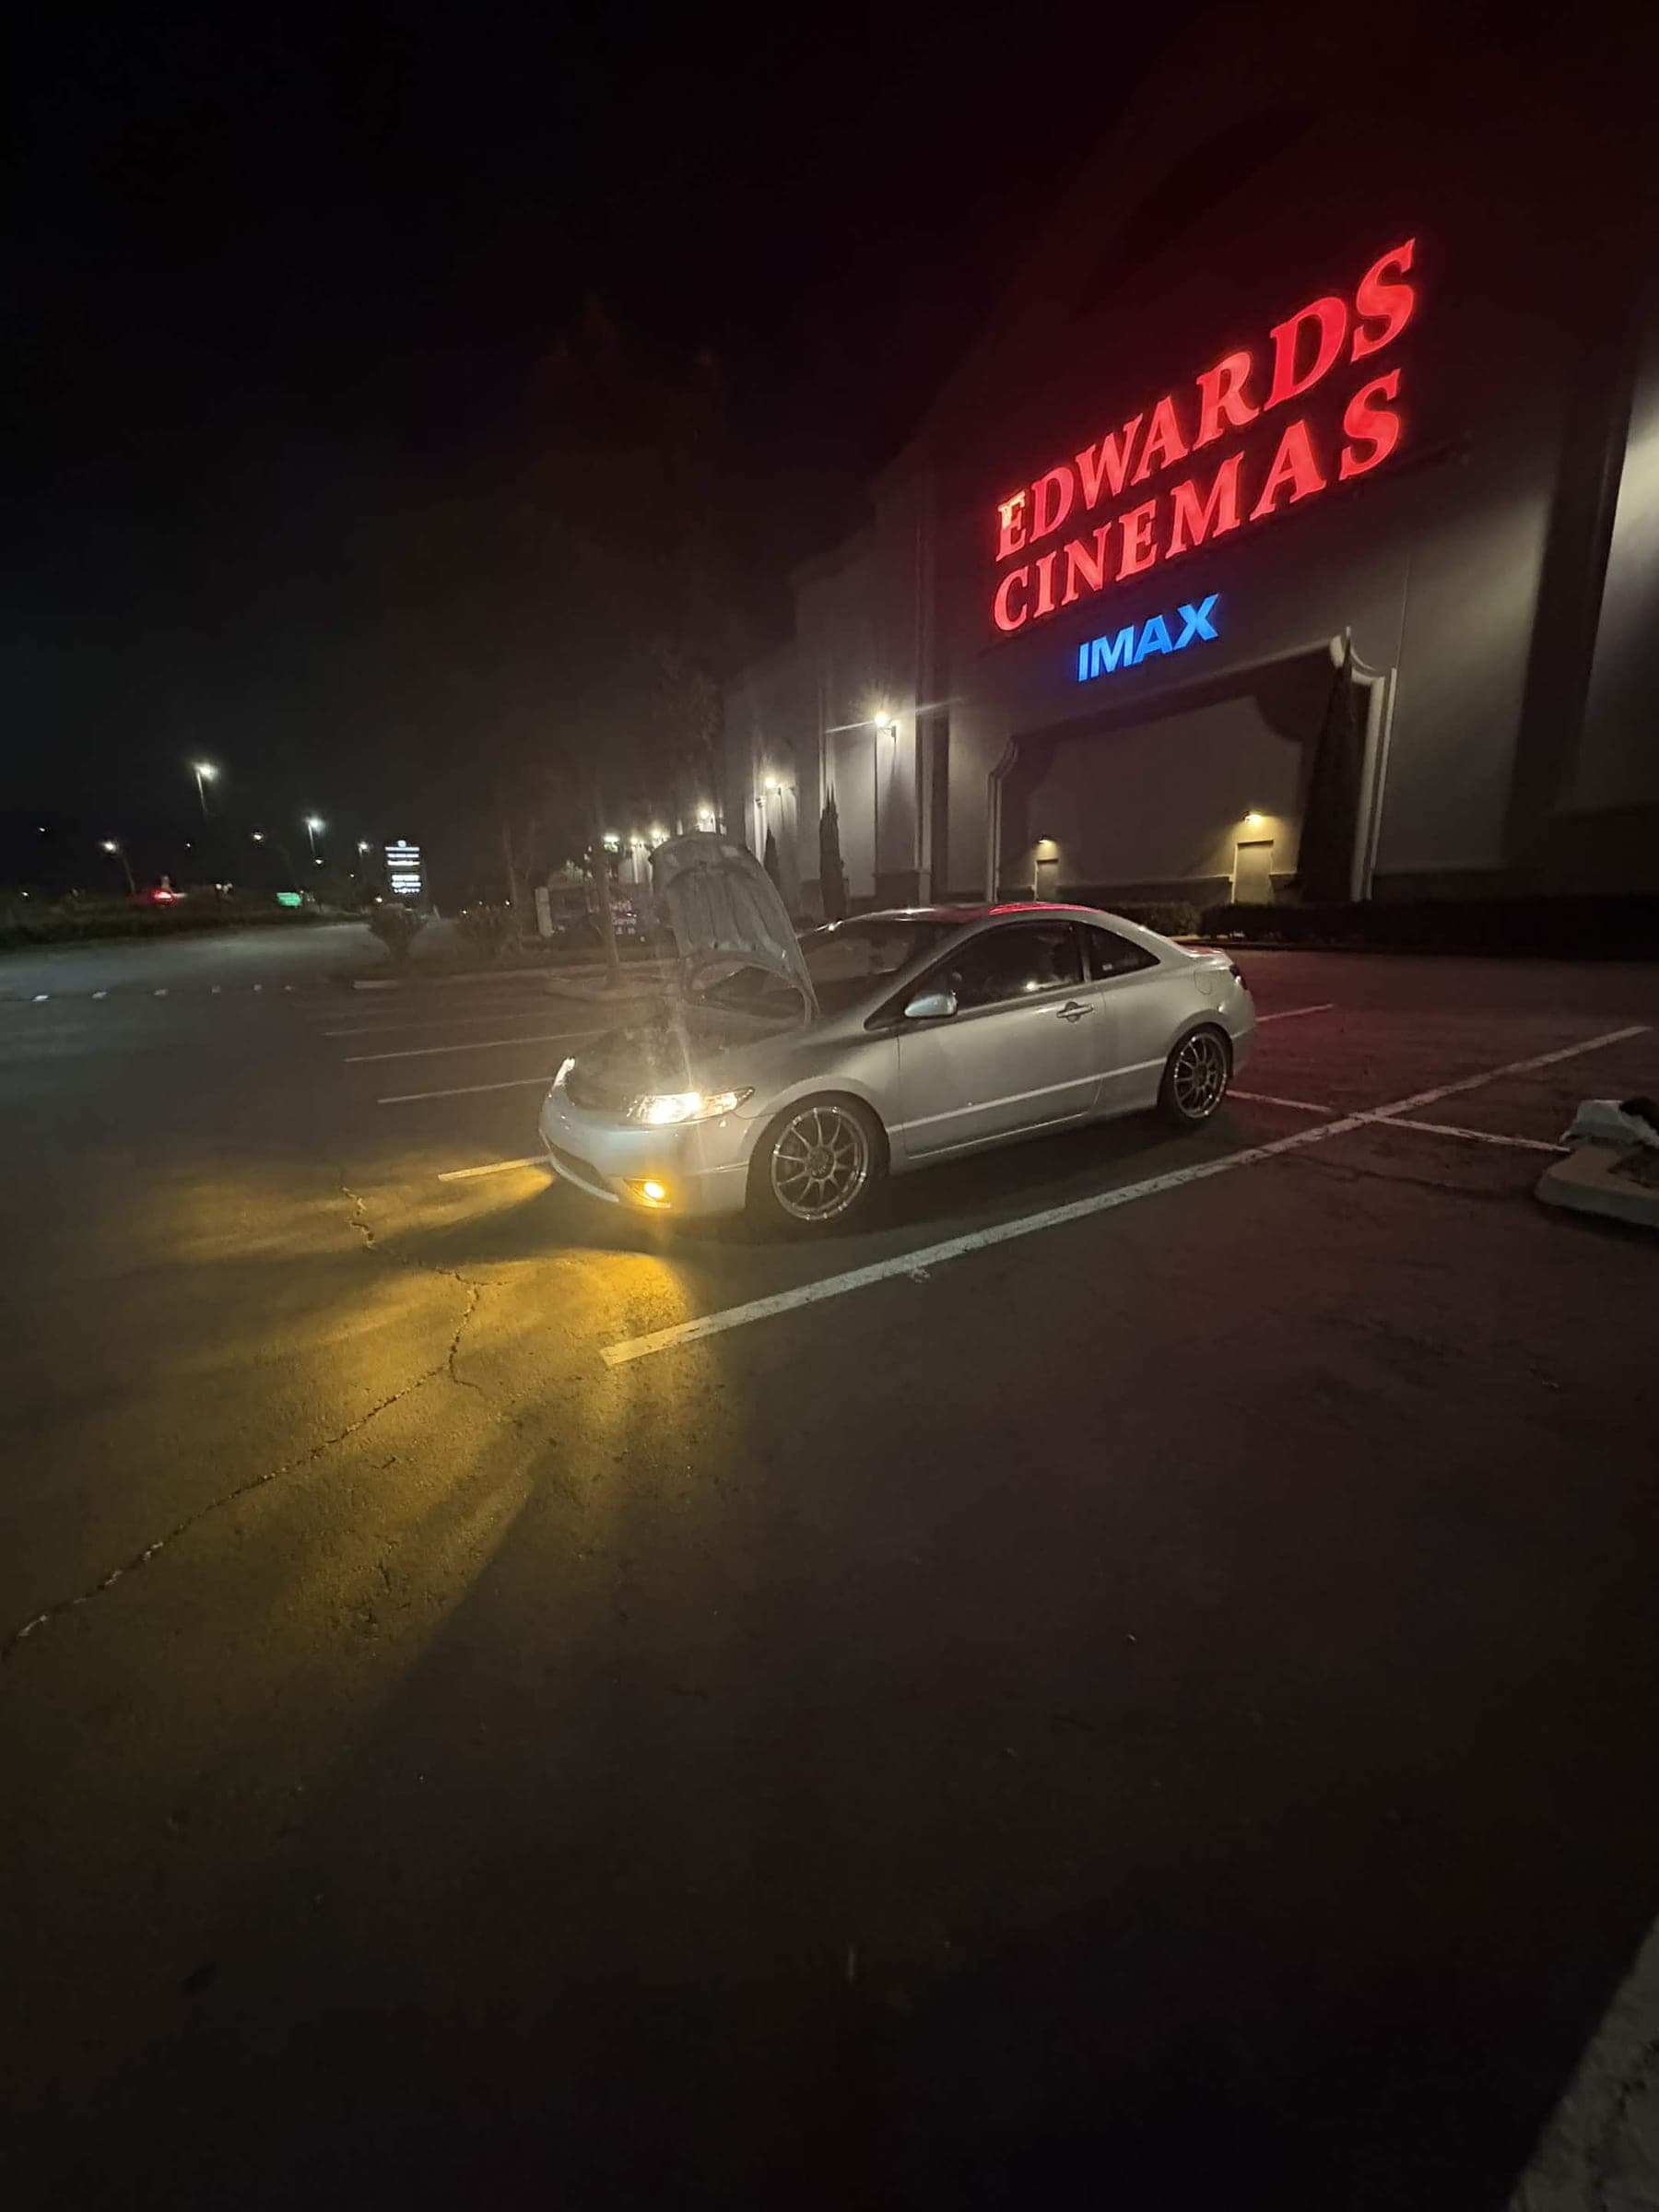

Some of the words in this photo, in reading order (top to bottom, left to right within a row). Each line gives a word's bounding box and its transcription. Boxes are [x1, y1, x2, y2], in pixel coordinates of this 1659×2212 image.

[993, 368, 1401, 632] CINEMAS
[994, 237, 1416, 563] EDWARDS
[1077, 593, 1219, 683] IMAX
